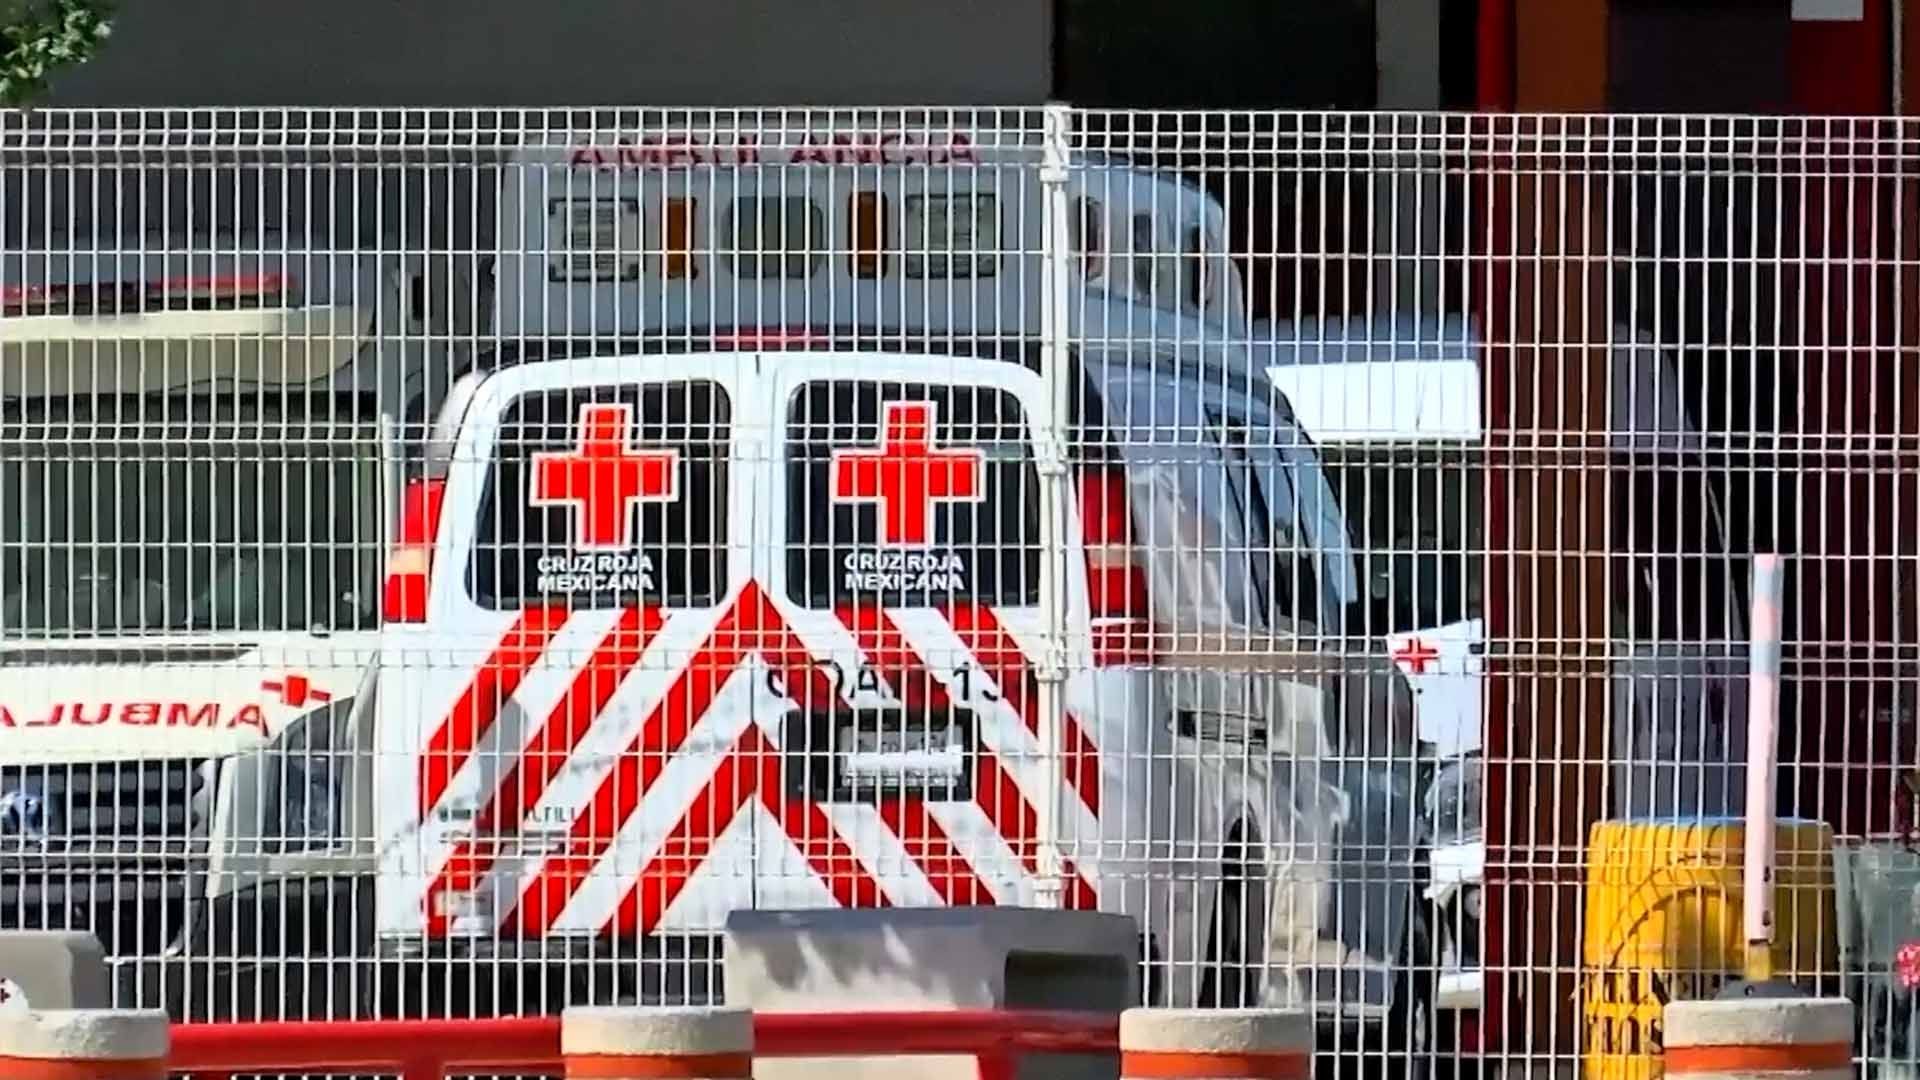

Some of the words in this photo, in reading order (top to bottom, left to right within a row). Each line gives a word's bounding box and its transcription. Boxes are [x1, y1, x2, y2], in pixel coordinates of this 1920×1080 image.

[537, 554, 595, 573] CRUZ
[597, 554, 653, 572] ROJA
[844, 552, 903, 571] CRUZ
[906, 554, 965, 572] ROJA
[537, 573, 654, 592] MEXICANA
[844, 573, 965, 591] MEXICANA
